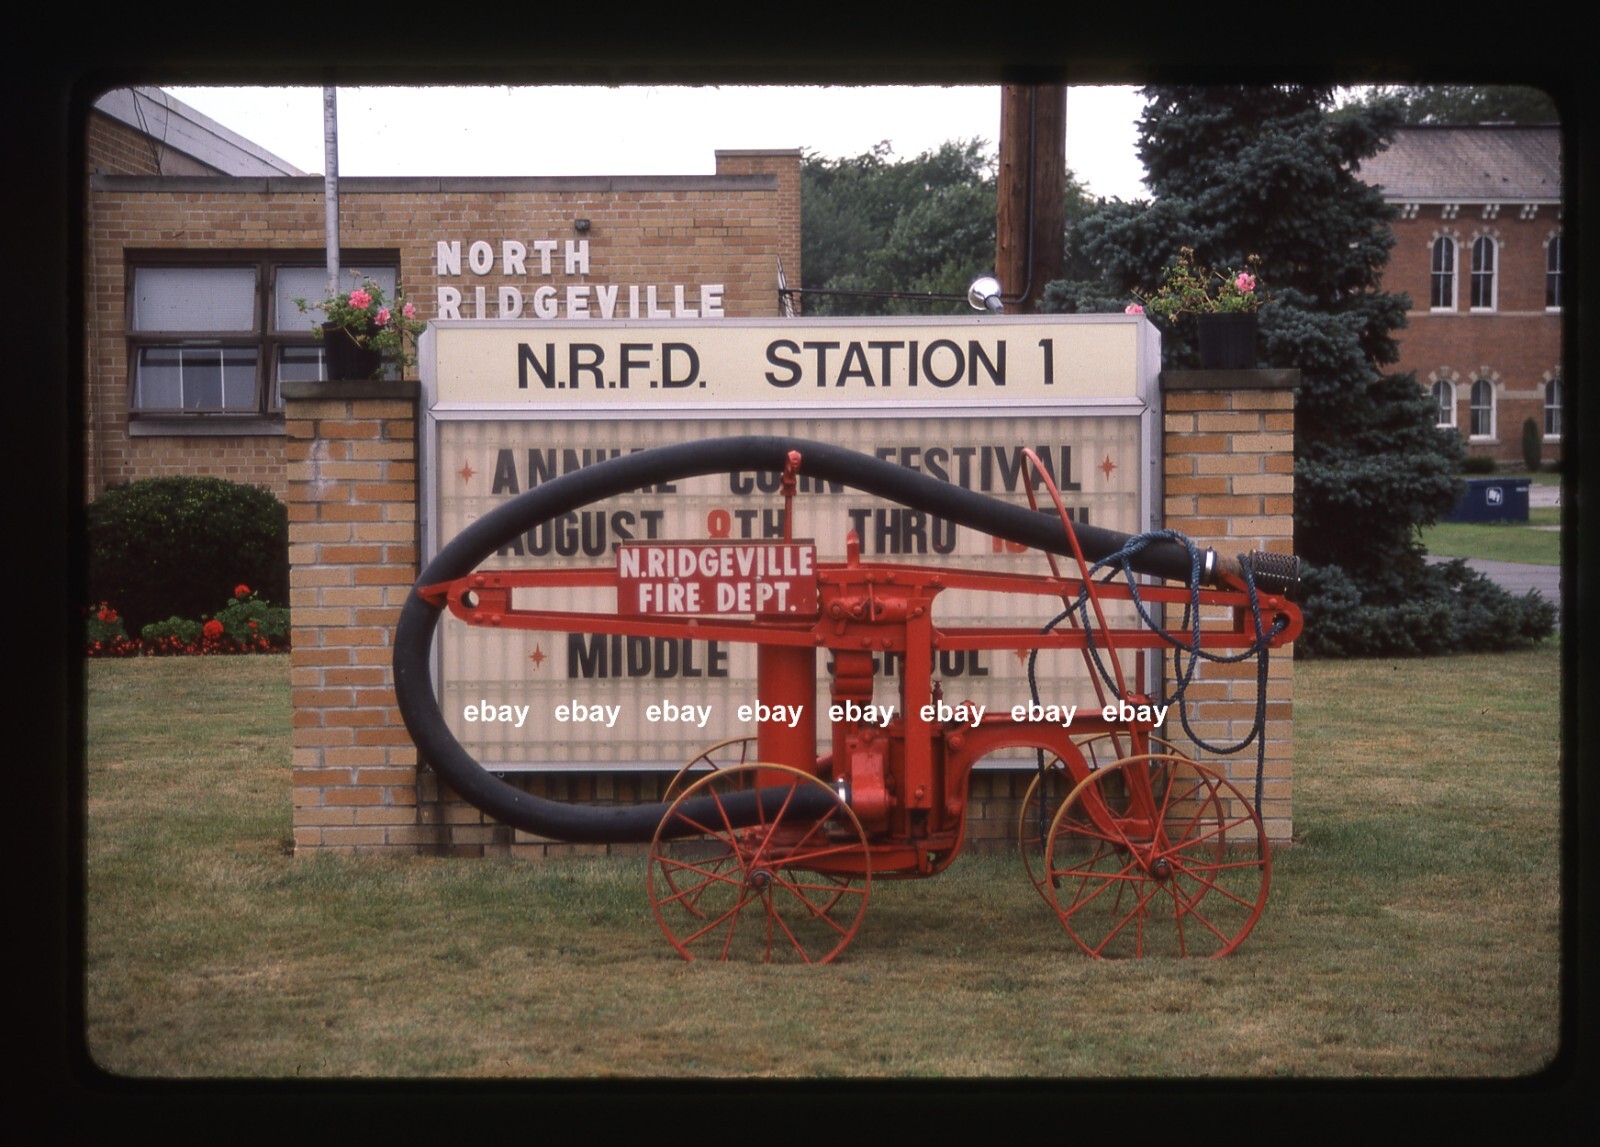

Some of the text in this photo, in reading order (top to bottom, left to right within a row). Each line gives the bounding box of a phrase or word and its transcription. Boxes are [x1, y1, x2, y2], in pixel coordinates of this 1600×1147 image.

[437, 240, 589, 275] NORTH
[437, 284, 725, 319] RIDGEVILLE
[517, 338, 1054, 389] N.R.F.D. STATION 1
[876, 445, 1082, 492] ESTIVAL
[848, 509, 956, 555] THRU
[620, 546, 813, 578] N.RIDGEVILLE
[639, 581, 797, 613] FIRE DEPT.
[567, 632, 728, 678] MIDDLE
